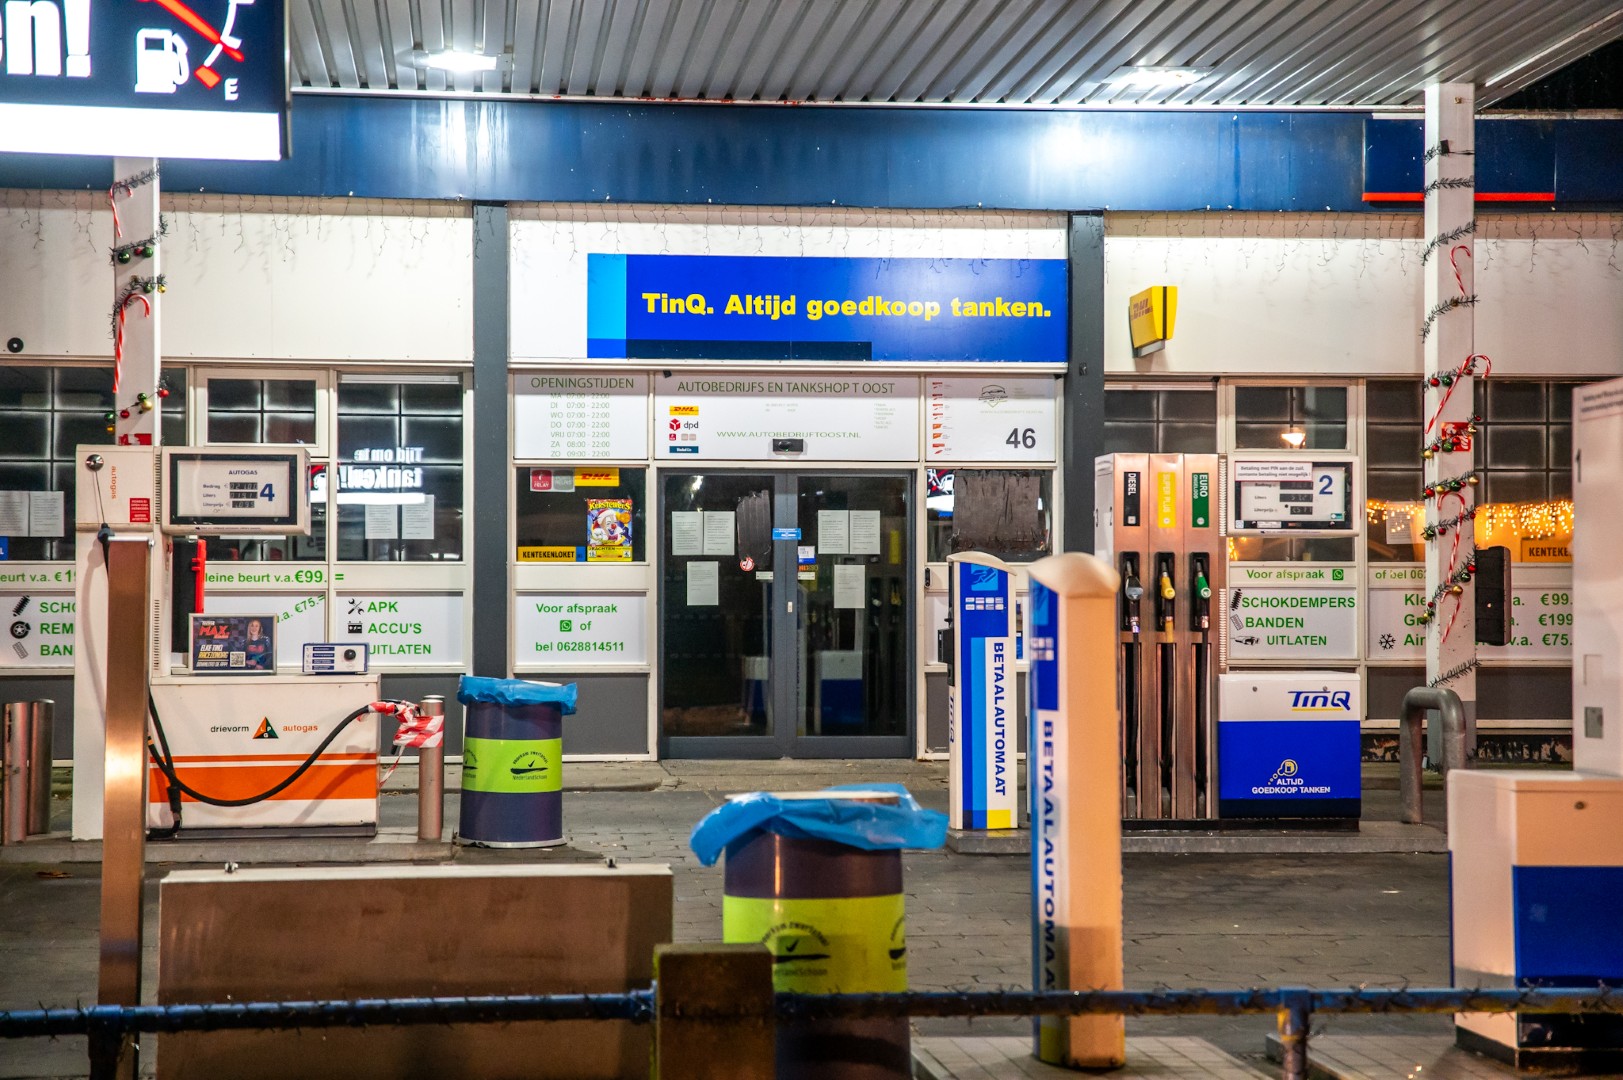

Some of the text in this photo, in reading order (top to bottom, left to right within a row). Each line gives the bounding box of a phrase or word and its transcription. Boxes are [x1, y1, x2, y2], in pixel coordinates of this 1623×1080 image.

[0, 0, 91, 77] n!
[642, 293, 1051, 321] TinQ. Altijd goedkoop tanken.
[531, 377, 634, 389] OPENINGSTIJDEN
[677, 381, 764, 394] AUTOBEDRIJFS
[768, 382, 783, 393] EN
[786, 382, 850, 393] TANKSHOP
[862, 383, 895, 394] OOST
[684, 421, 698, 430] dpd
[1006, 428, 1036, 449] 46
[1127, 473, 1136, 496] DIESEL
[1199, 474, 1208, 497] EURO
[1318, 474, 1333, 495] 2
[259, 483, 275, 502] 4
[522, 551, 575, 559] KENTEKENLOKET
[1528, 547, 1572, 557] KENTEKE
[31, 573, 51, 582] v.a.
[54, 570, 76, 583] €1
[203, 572, 235, 583] leine
[238, 572, 270, 583] beurt
[274, 573, 294, 583] v.a.
[1246, 569, 1325, 581] Voor afspraak
[1375, 570, 1426, 579] of bel 06
[367, 601, 398, 613] APK
[1241, 597, 1356, 608] SCHOKDEMPERS
[536, 603, 617, 615] Voor afspraak
[368, 622, 422, 634] ACCU'S
[580, 621, 592, 631] of
[1245, 617, 1304, 628] BANDEN
[39, 623, 74, 635] REM
[535, 642, 624, 651] bel 0628814511
[1267, 635, 1327, 646] UITLATEN
[39, 645, 73, 656] BAN
[368, 644, 432, 655] UITLATEN
[1288, 690, 1351, 711] TinQ
[993, 642, 1006, 796] BETAALAUTOMAAT
[210, 725, 249, 733] drievorm
[282, 724, 318, 732] autogas
[1252, 786, 1331, 794] GOEDKOOP TANKEN
[1042, 720, 1055, 992] BETAALAUTOMAA
